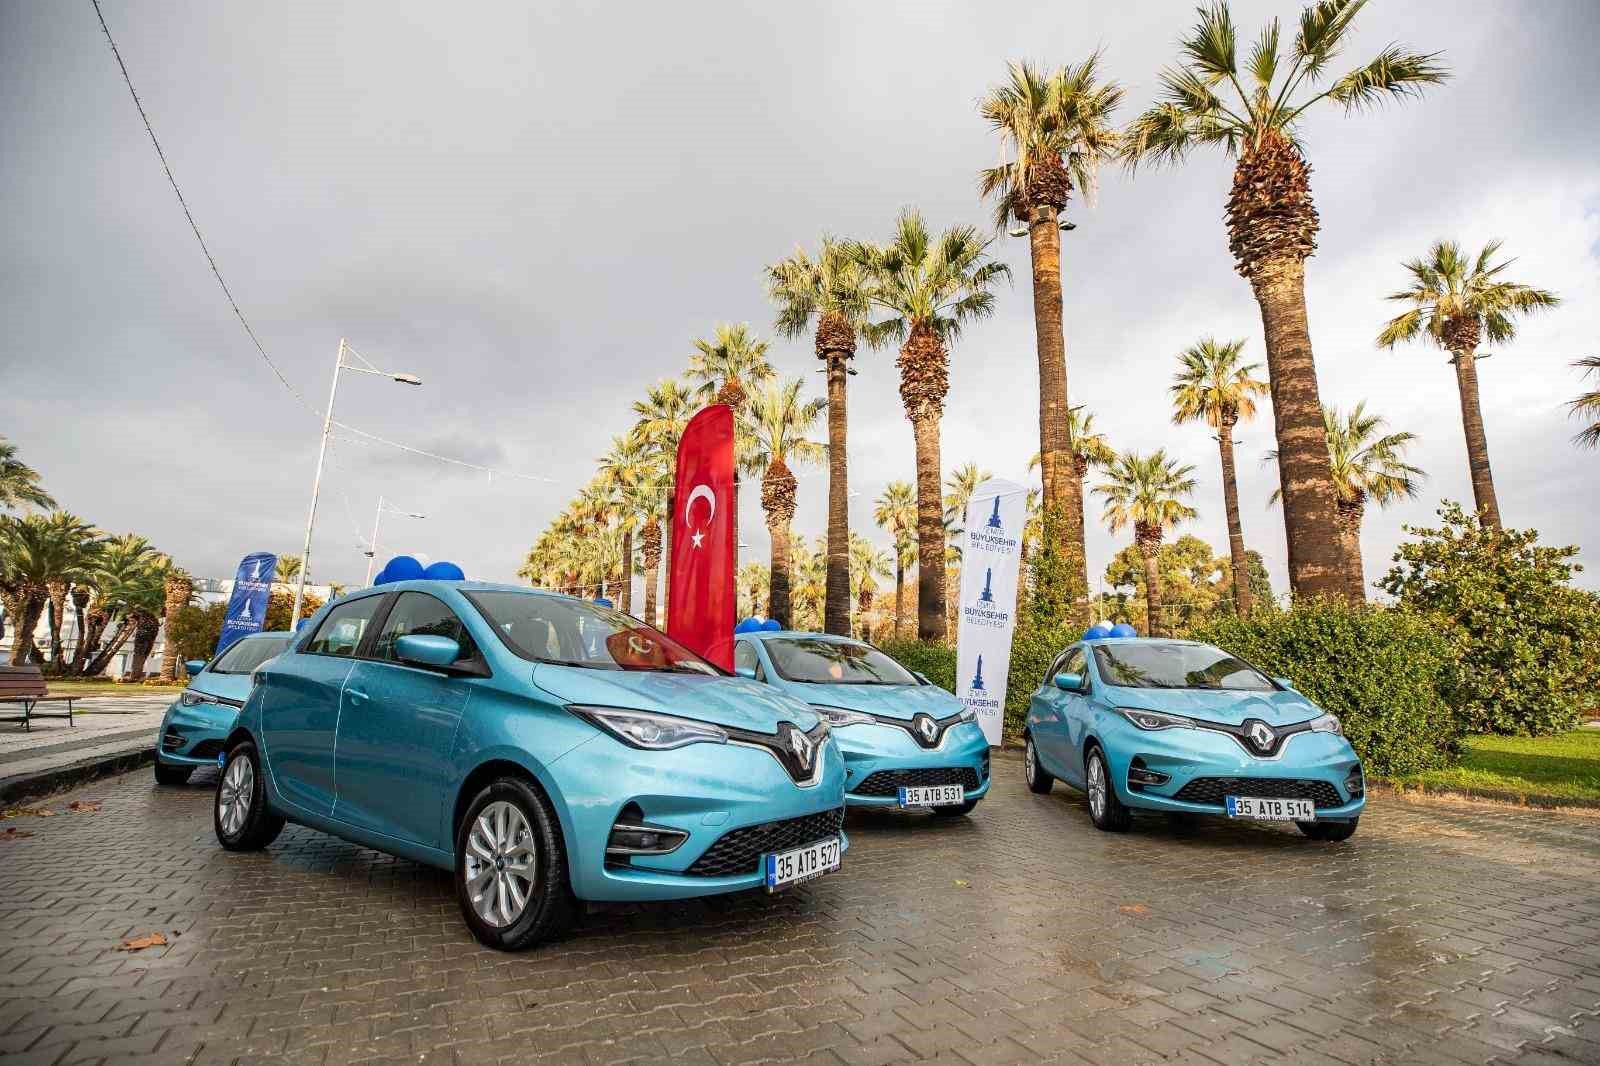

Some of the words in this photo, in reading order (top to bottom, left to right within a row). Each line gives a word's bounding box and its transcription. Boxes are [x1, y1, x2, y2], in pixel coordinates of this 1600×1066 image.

[907, 790, 920, 803] 35
[924, 788, 941, 802] ATB
[944, 787, 961, 801] 531
[1236, 800, 1252, 815] 35
[1260, 801, 1282, 816] ATB
[1287, 802, 1311, 817] 514
[778, 856, 793, 880] 35
[798, 849, 817, 875] ATB
[821, 842, 838, 867] 527
